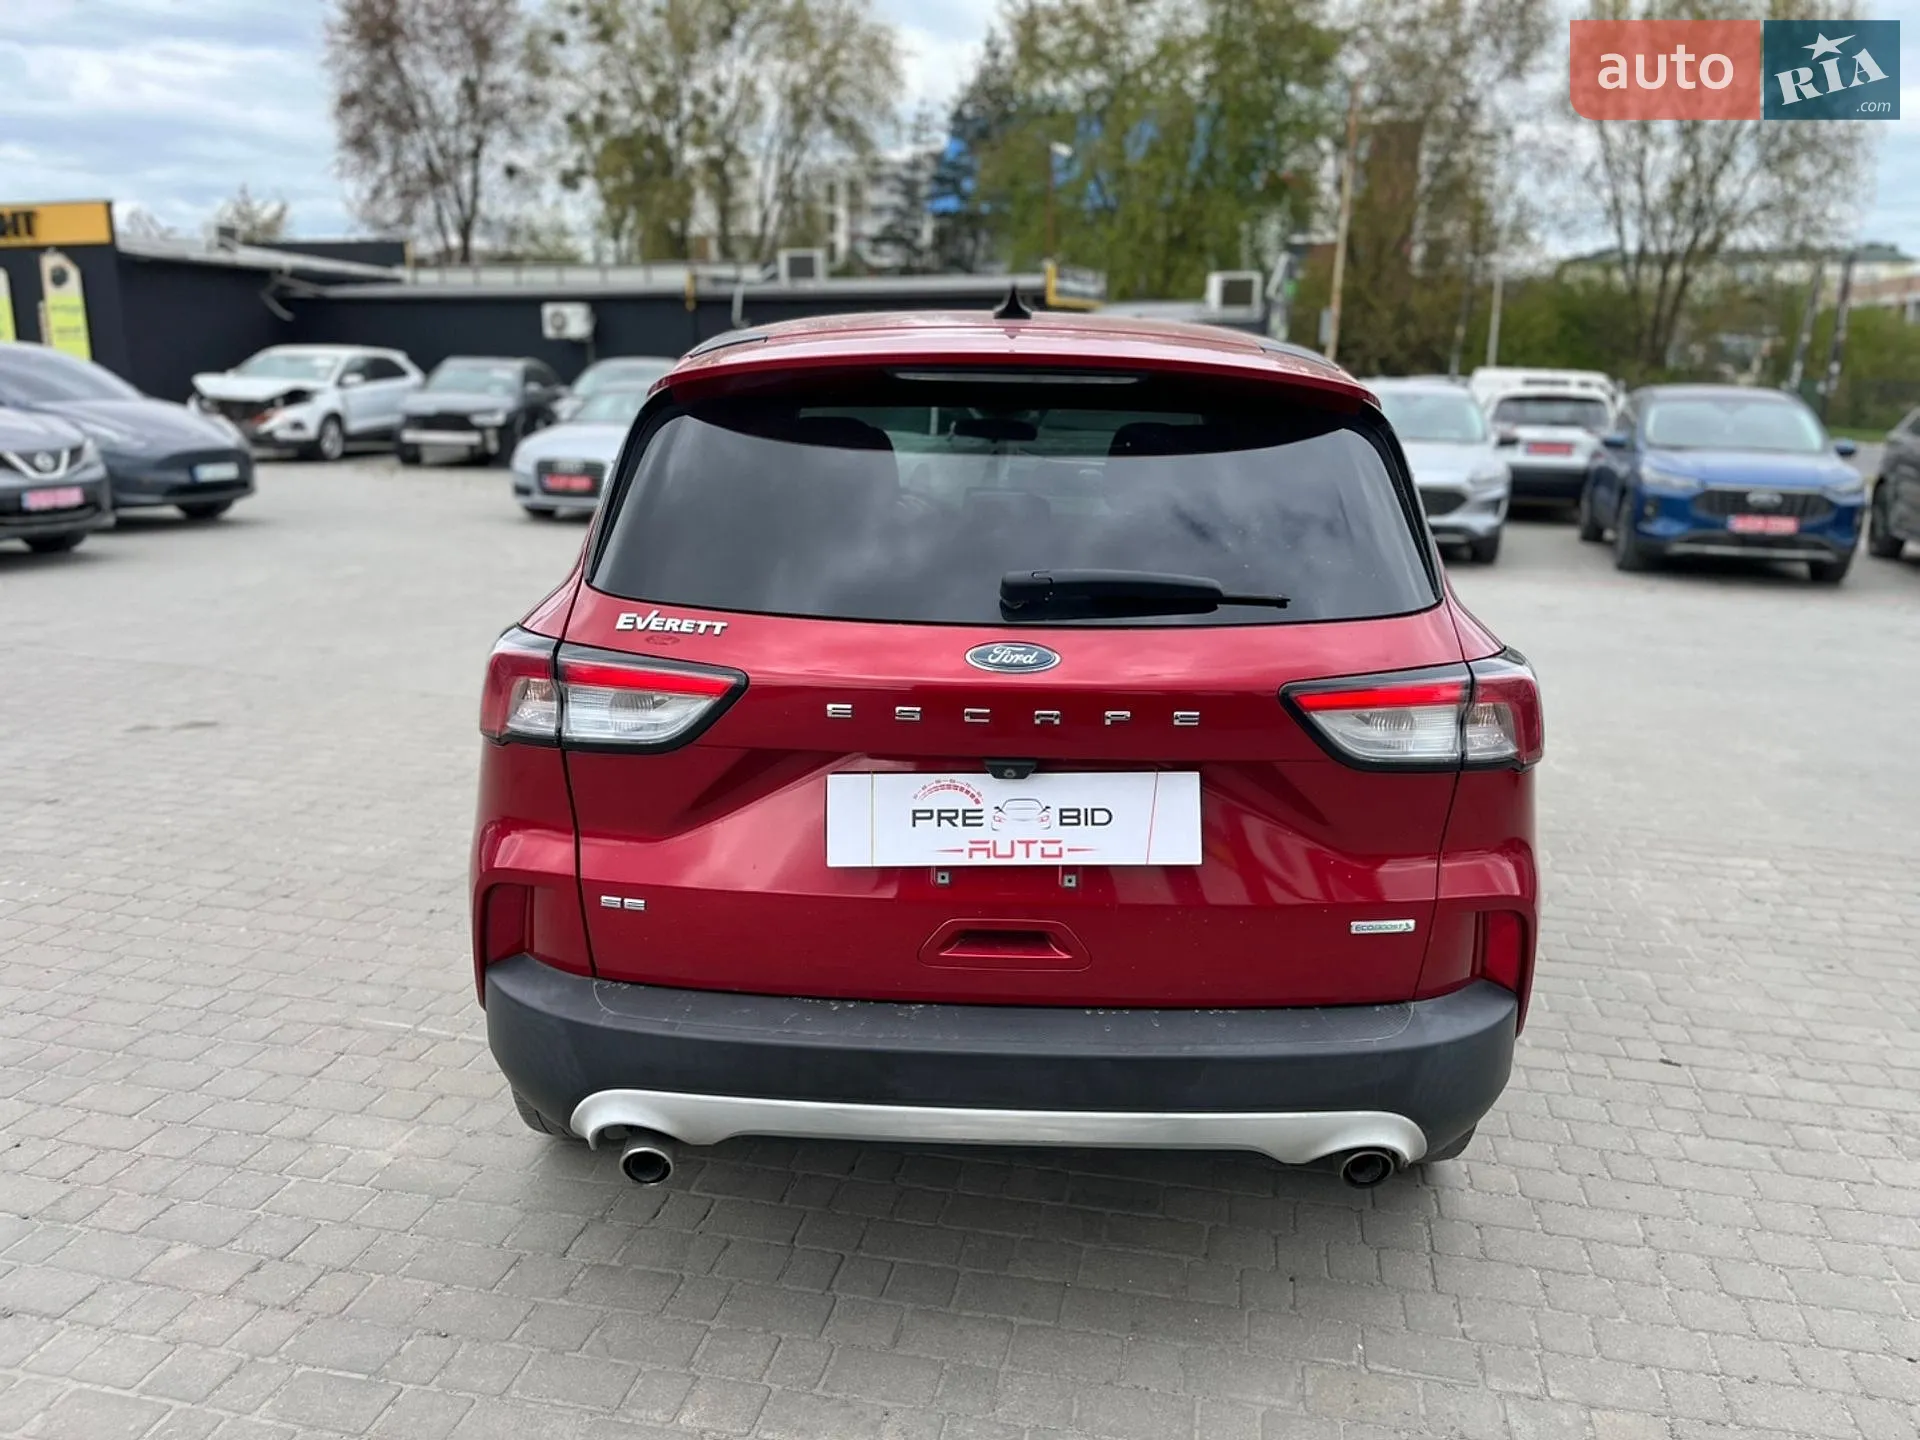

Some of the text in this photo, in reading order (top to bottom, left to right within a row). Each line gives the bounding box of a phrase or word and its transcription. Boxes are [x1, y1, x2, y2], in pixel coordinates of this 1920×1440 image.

[615, 609, 728, 635] EVERETT
[826, 703, 1200, 726] ESCAPE
[912, 807, 1113, 827] PRE BID
[968, 839, 1063, 859] AUTO
[600, 895, 645, 911] SE
